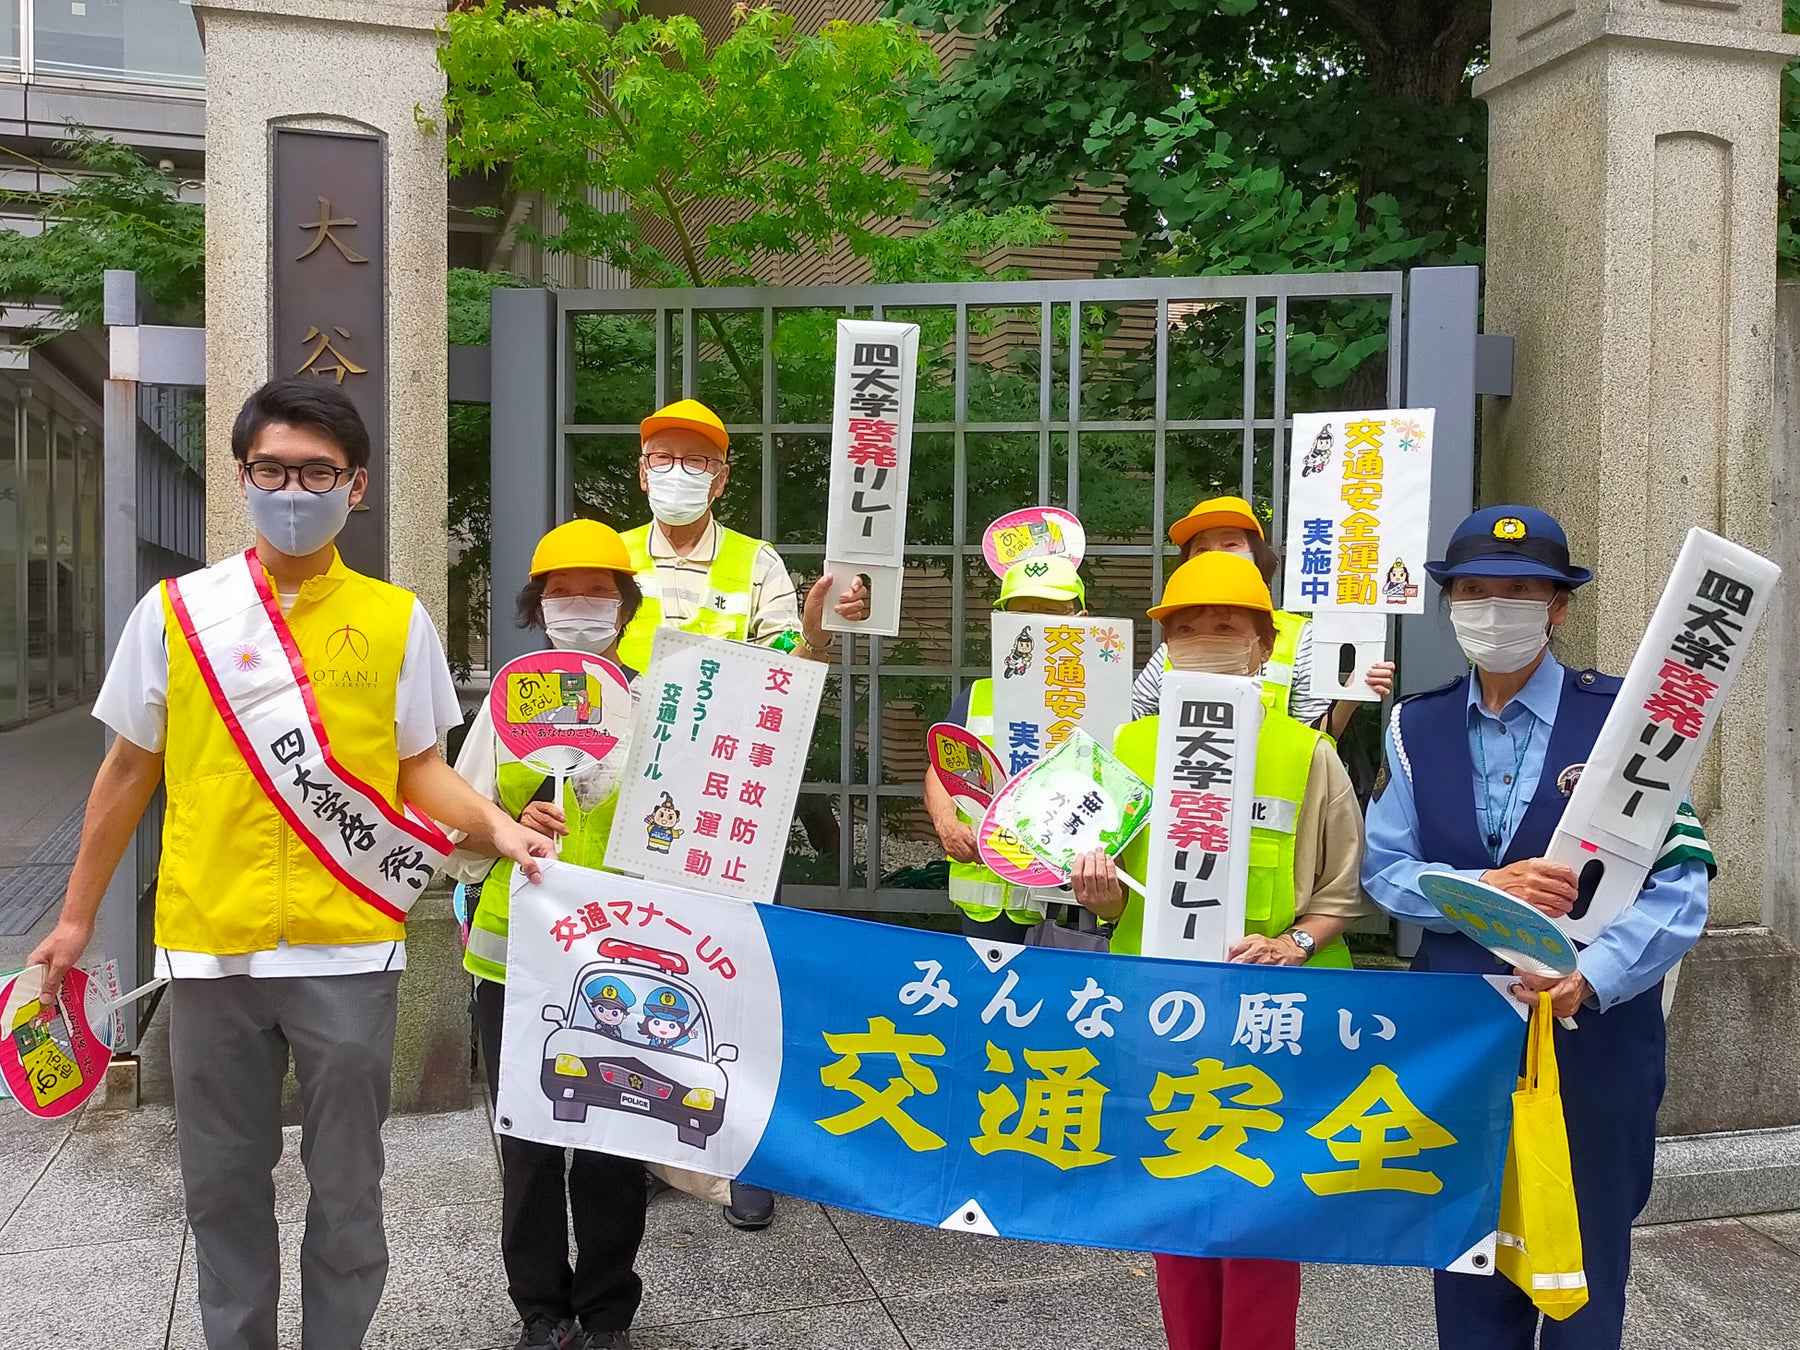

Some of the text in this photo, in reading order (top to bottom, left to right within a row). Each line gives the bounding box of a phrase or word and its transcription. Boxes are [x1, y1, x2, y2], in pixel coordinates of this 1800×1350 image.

[847, 342, 900, 538] 四大学啓発リレー
[1301, 517, 1333, 605] 実施中
[1336, 419, 1387, 606] 交通安全運動
[714, 595, 727, 610] 北
[313, 669, 379, 683] OTANI
[519, 690, 557, 717] 危ない
[689, 658, 720, 742] 守ろう!
[1620, 567, 1754, 820] 四大学啓発リレー
[644, 682, 684, 781] 交通ルール
[722, 667, 794, 883] 交通事故防止
[685, 735, 739, 876] 府民運動
[1166, 700, 1234, 939] 四大学啓発リレー
[897, 958, 1398, 1057] みんなの願い
[621, 1095, 650, 1109] POLICE
[814, 1016, 1459, 1197] 交通安全
